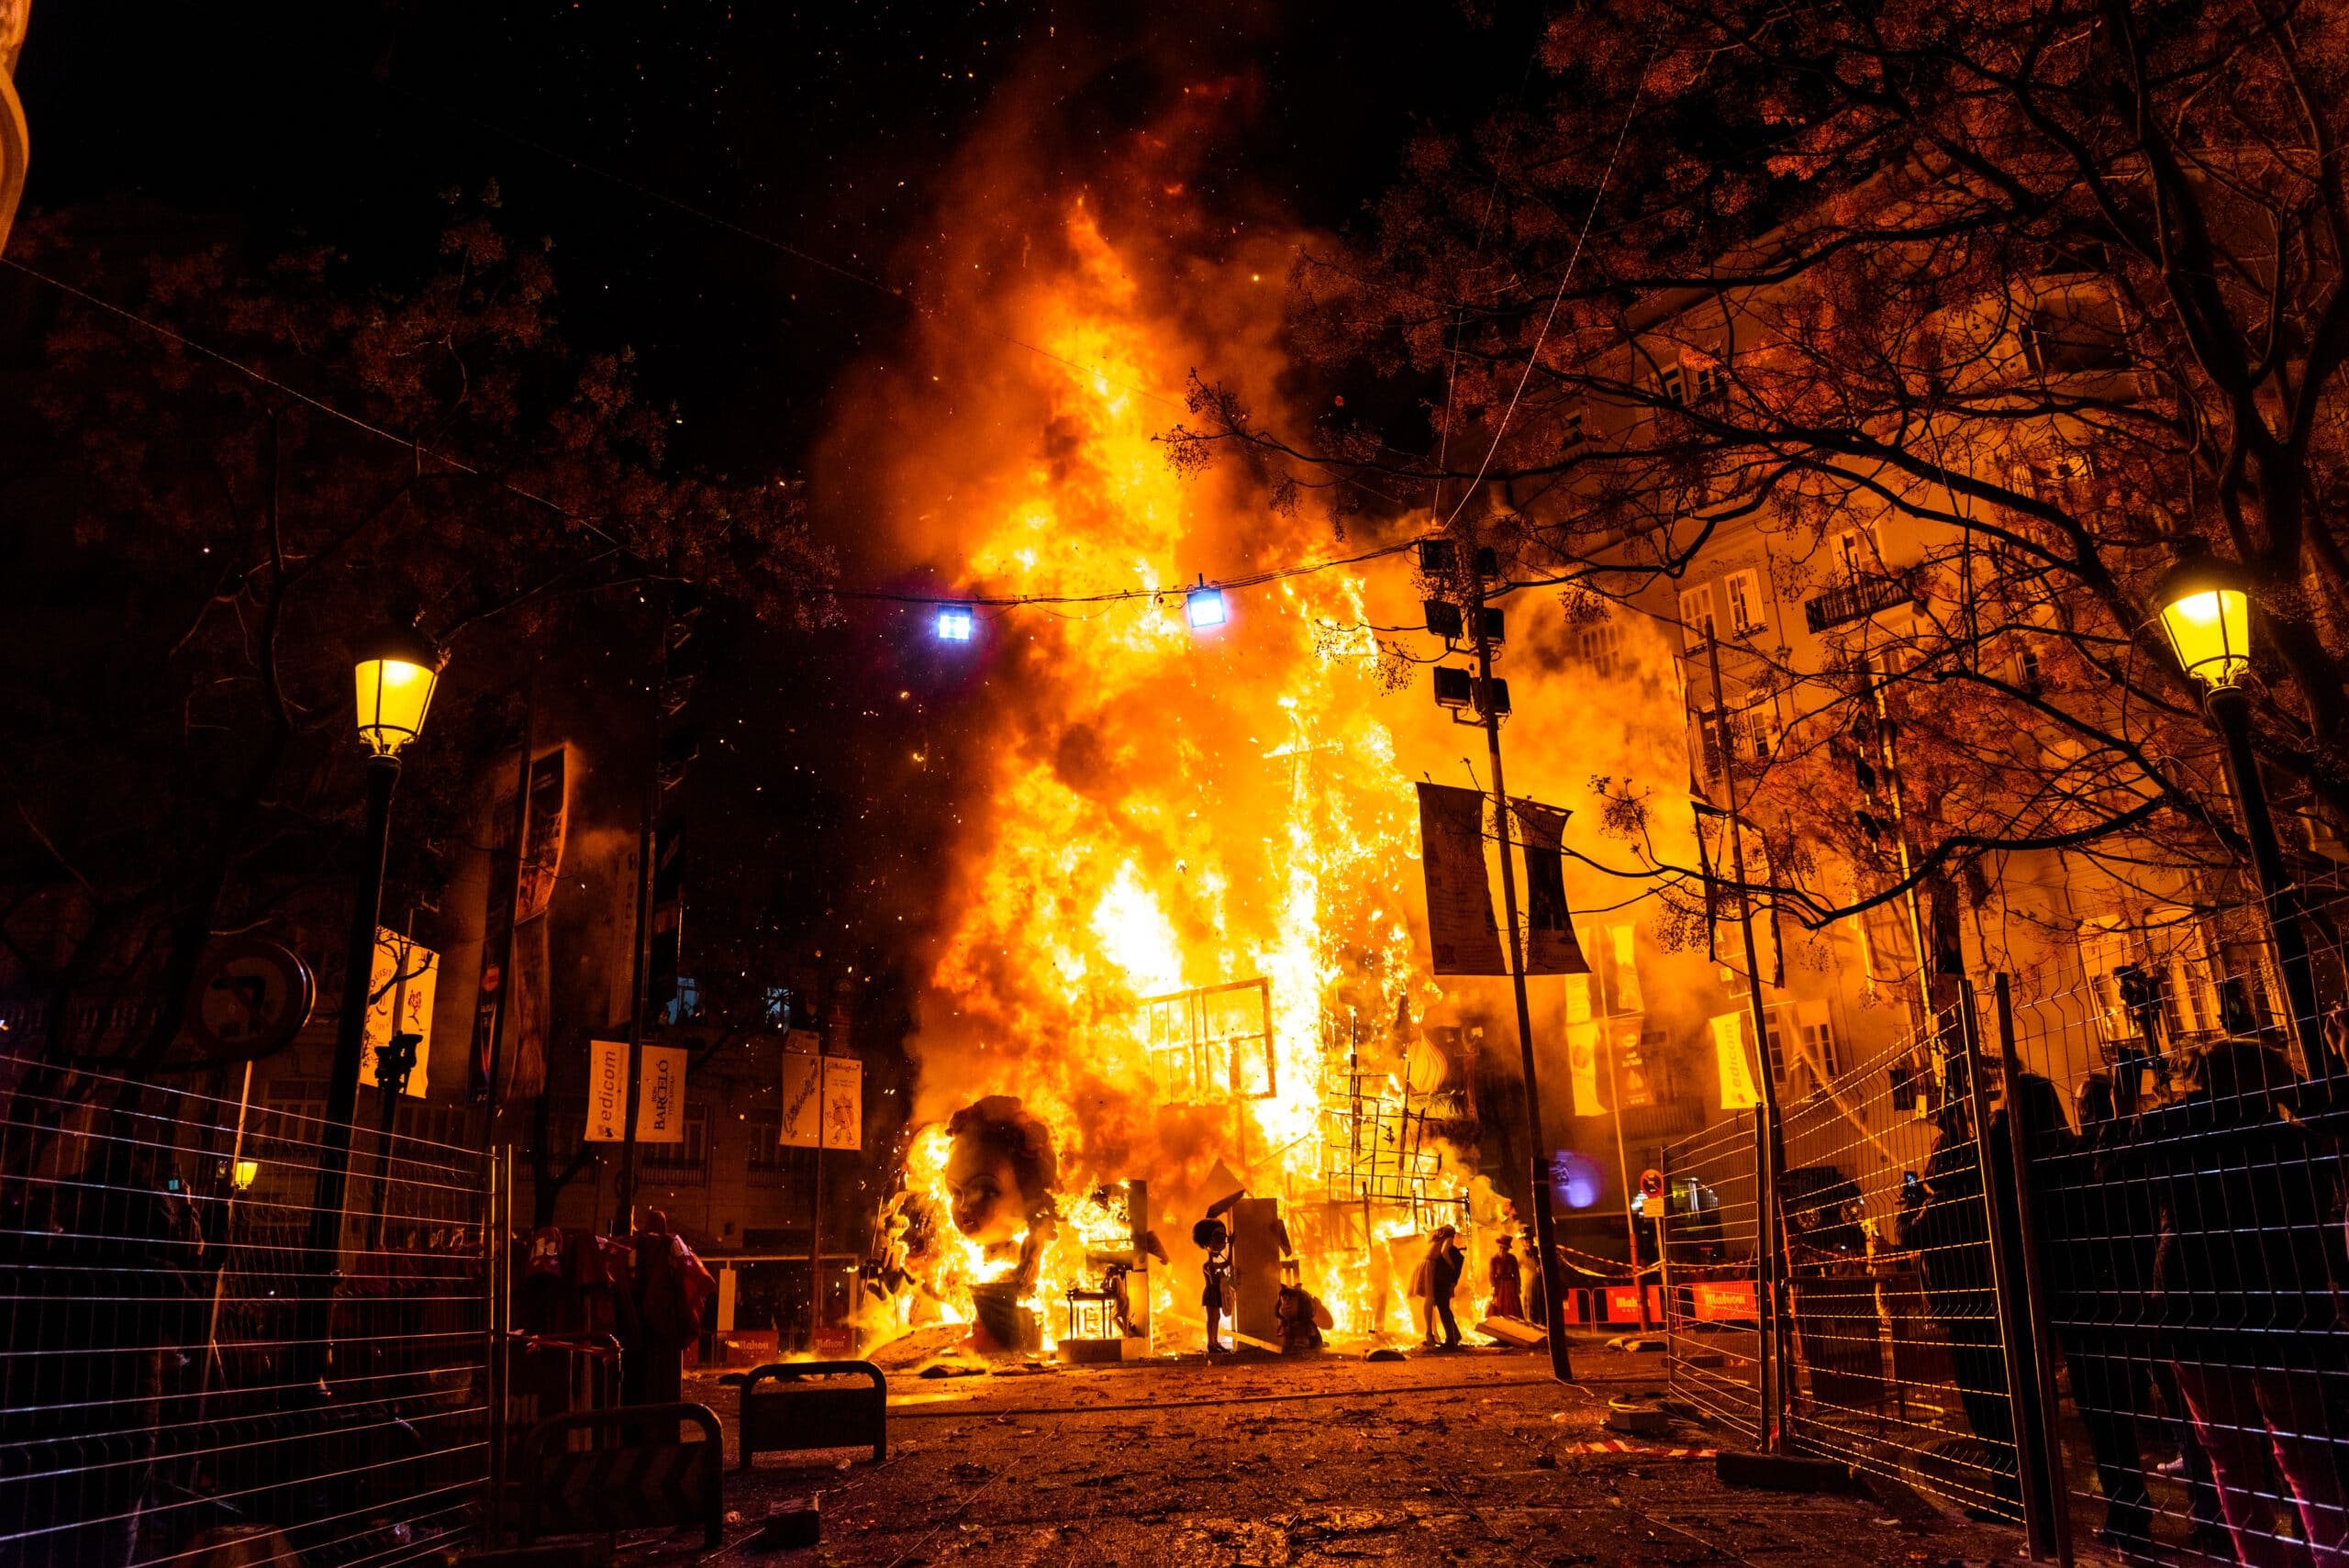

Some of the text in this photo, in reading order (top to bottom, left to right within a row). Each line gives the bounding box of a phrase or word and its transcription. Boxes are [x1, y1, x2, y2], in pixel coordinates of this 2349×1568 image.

[598, 1051, 617, 1122] edicom
[1725, 1023, 1742, 1087] edicom
[653, 1060, 668, 1130] BARCELÓ
